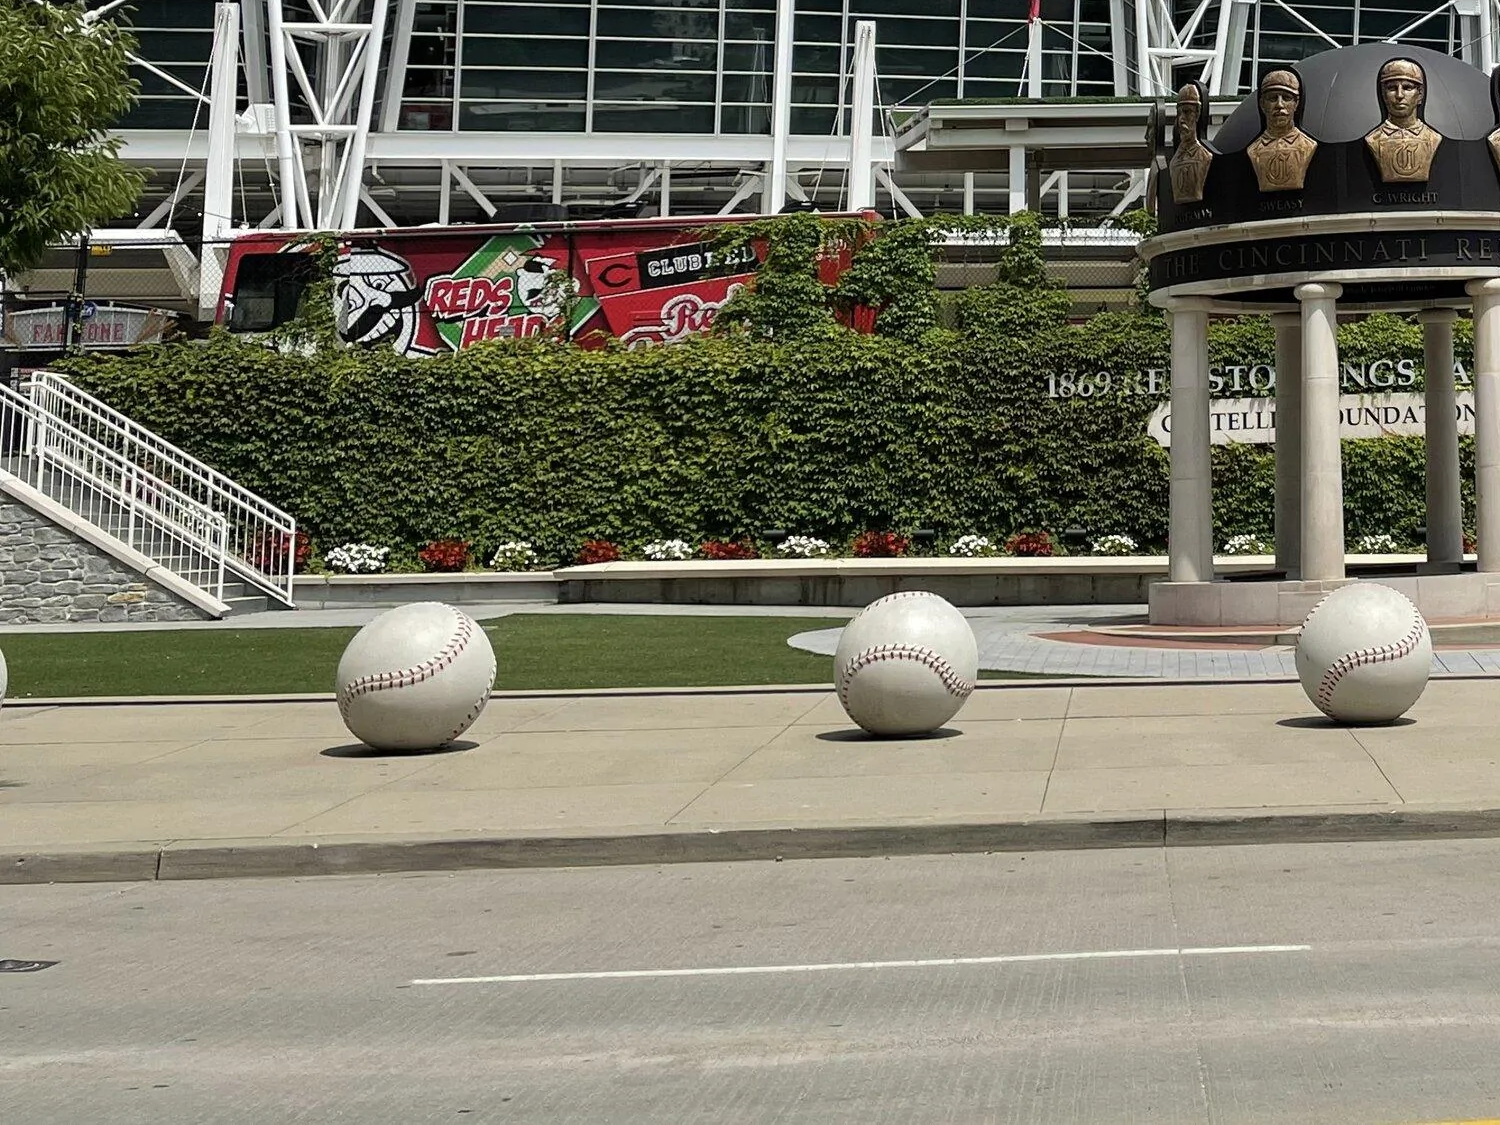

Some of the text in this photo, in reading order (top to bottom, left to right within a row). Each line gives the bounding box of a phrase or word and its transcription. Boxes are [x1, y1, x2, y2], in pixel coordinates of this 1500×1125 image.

[1259, 198, 1304, 212] SWEASY
[1388, 191, 1439, 204] WRIGHT
[647, 254, 702, 277] CLUB
[1164, 250, 1199, 279] THE
[1218, 238, 1428, 271] CINCINNATI
[426, 276, 513, 316] REDS
[82, 323, 124, 342] ONE
[1044, 370, 1112, 399] 1869
